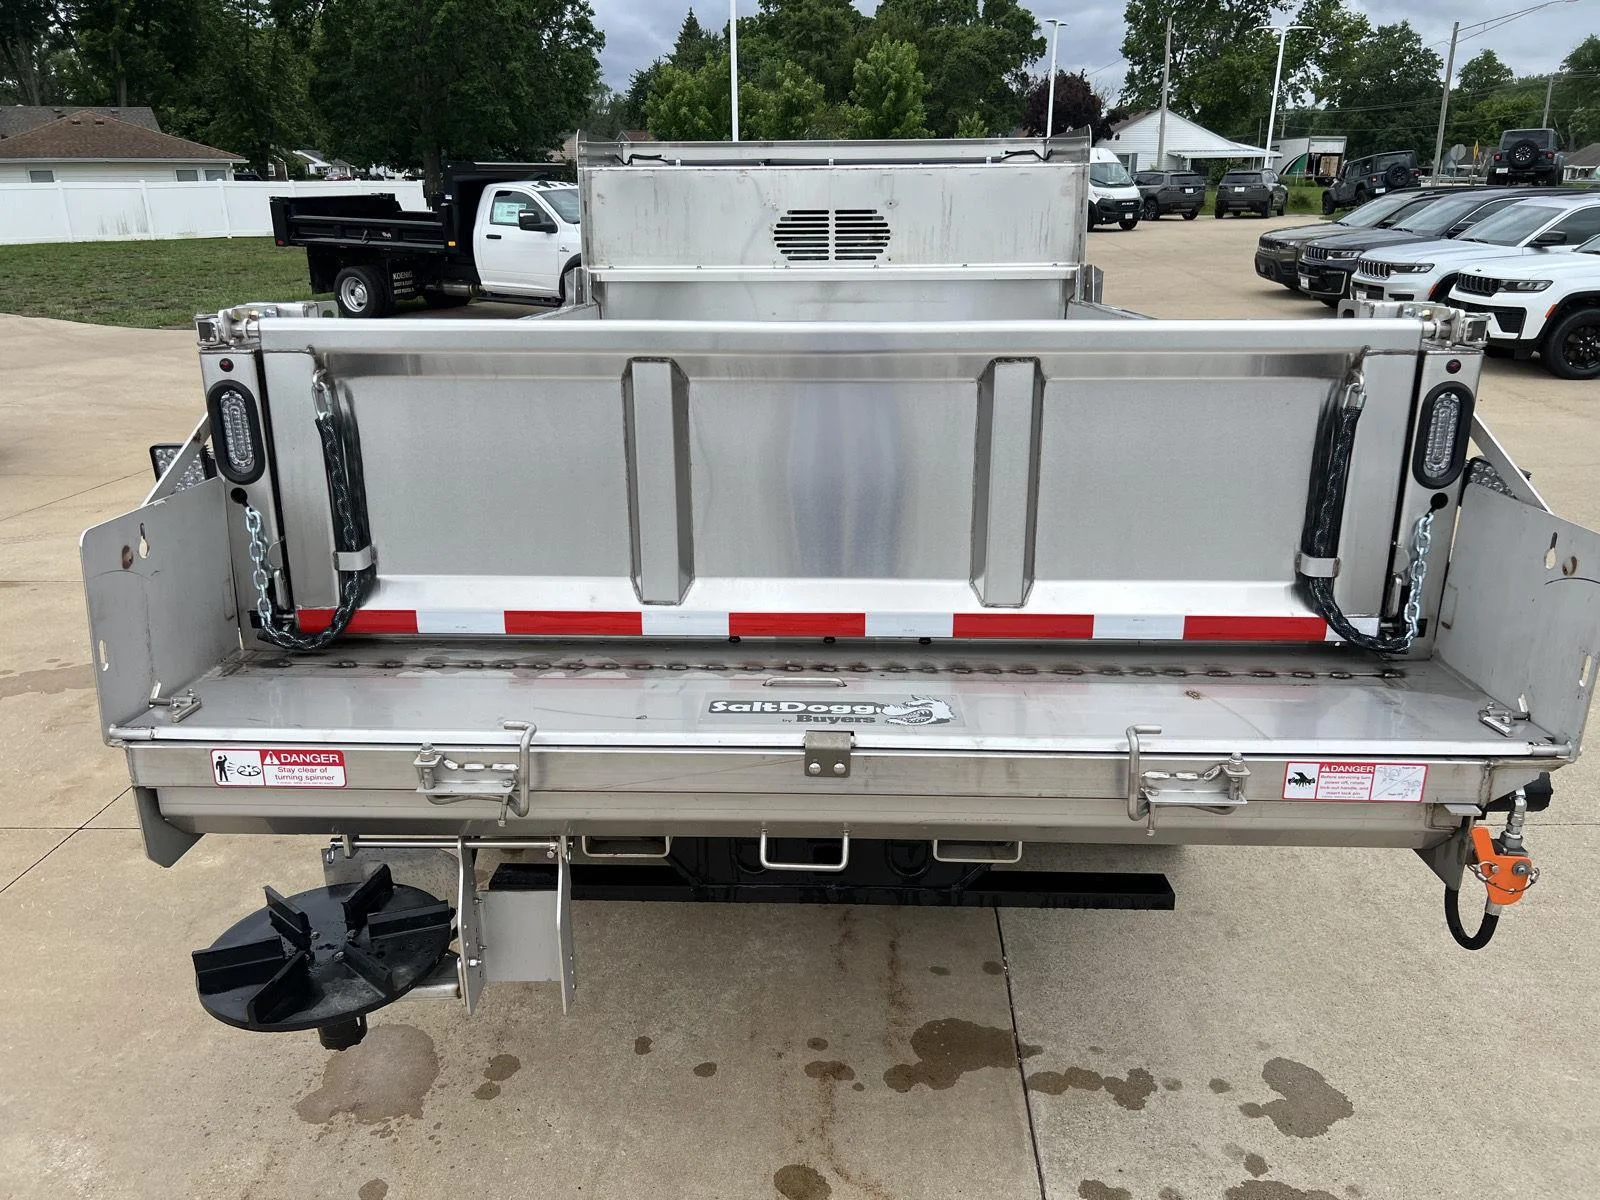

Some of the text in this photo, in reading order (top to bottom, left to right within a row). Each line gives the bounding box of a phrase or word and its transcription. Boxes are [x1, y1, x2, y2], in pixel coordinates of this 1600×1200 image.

[711, 701, 876, 715] SaltDogg
[796, 714, 876, 725] Buyers
[280, 753, 340, 764] DANGER
[277, 766, 296, 775] Stay
[1331, 765, 1375, 773] DANGER
